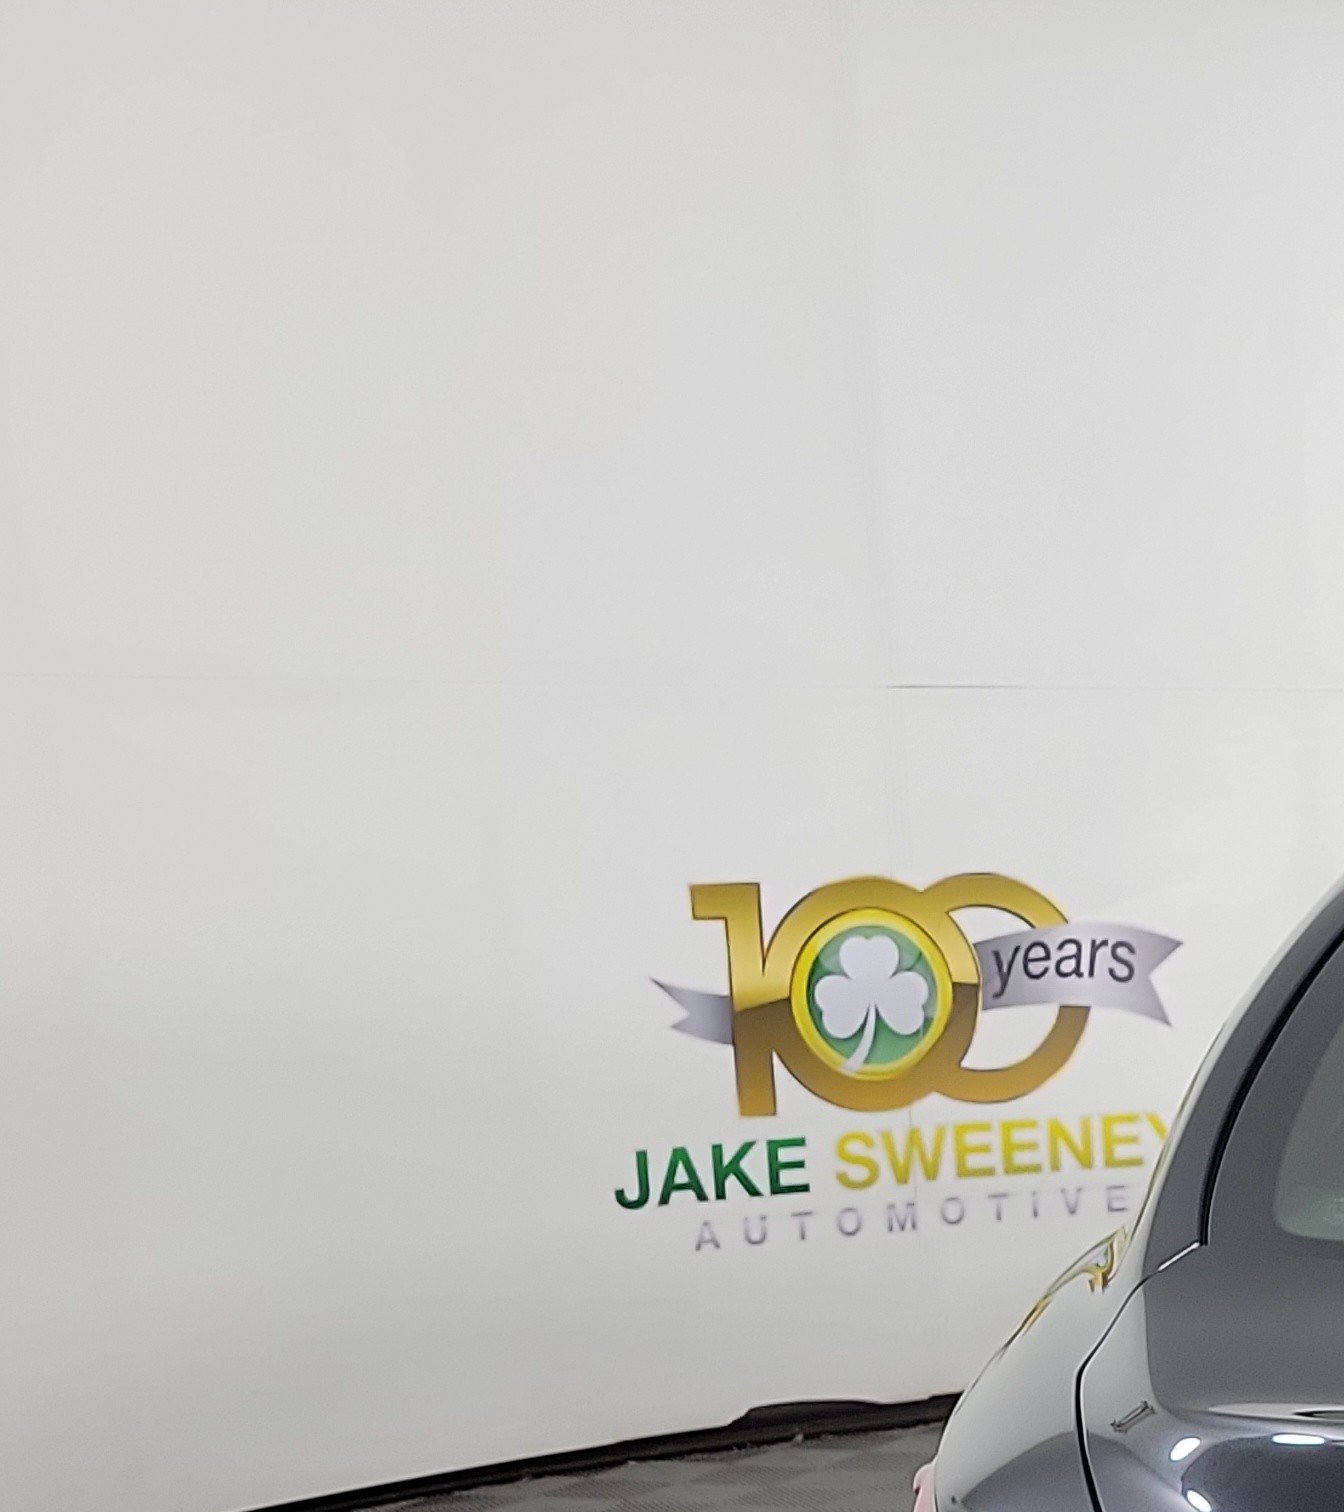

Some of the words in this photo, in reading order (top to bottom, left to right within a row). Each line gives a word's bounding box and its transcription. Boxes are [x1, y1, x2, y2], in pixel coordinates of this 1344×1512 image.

[690, 872, 1092, 1117] 100
[990, 937, 1137, 998] years
[614, 1136, 811, 1211] JAKE
[694, 1183, 1129, 1252] AUTOMOTIVE
